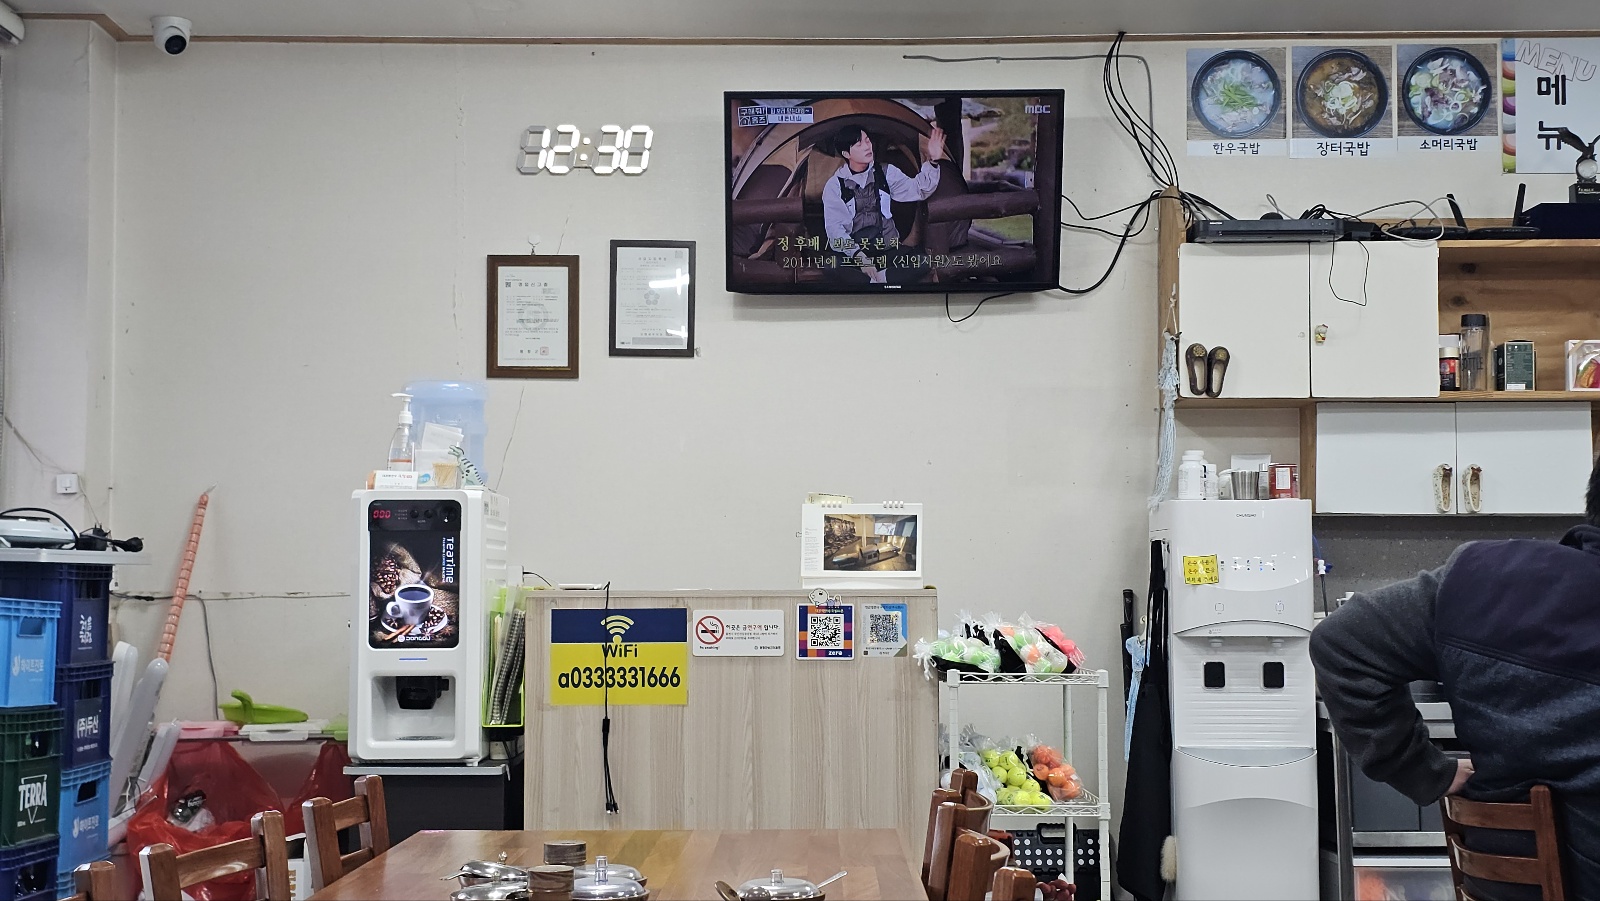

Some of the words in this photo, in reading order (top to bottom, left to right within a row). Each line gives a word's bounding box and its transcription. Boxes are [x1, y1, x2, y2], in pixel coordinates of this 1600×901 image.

[1515, 39, 1597, 82] MENU
[1024, 104, 1051, 114] MBC
[537, 124, 654, 174] 12:30
[1212, 142, 1261, 155] 한우국밥
[1316, 141, 1370, 157] 장터국밥
[1419, 138, 1478, 151] 소머리국밥
[777, 236, 789, 251] 정
[794, 236, 821, 251] 후배
[859, 238, 871, 251] 못
[873, 238, 886, 250] 본
[782, 255, 838, 269] 2011년에
[966, 254, 1004, 269] 봤어요
[601, 644, 638, 658] WiFi
[558, 666, 681, 689] a0333331666
[18, 781, 48, 812] TERRA
